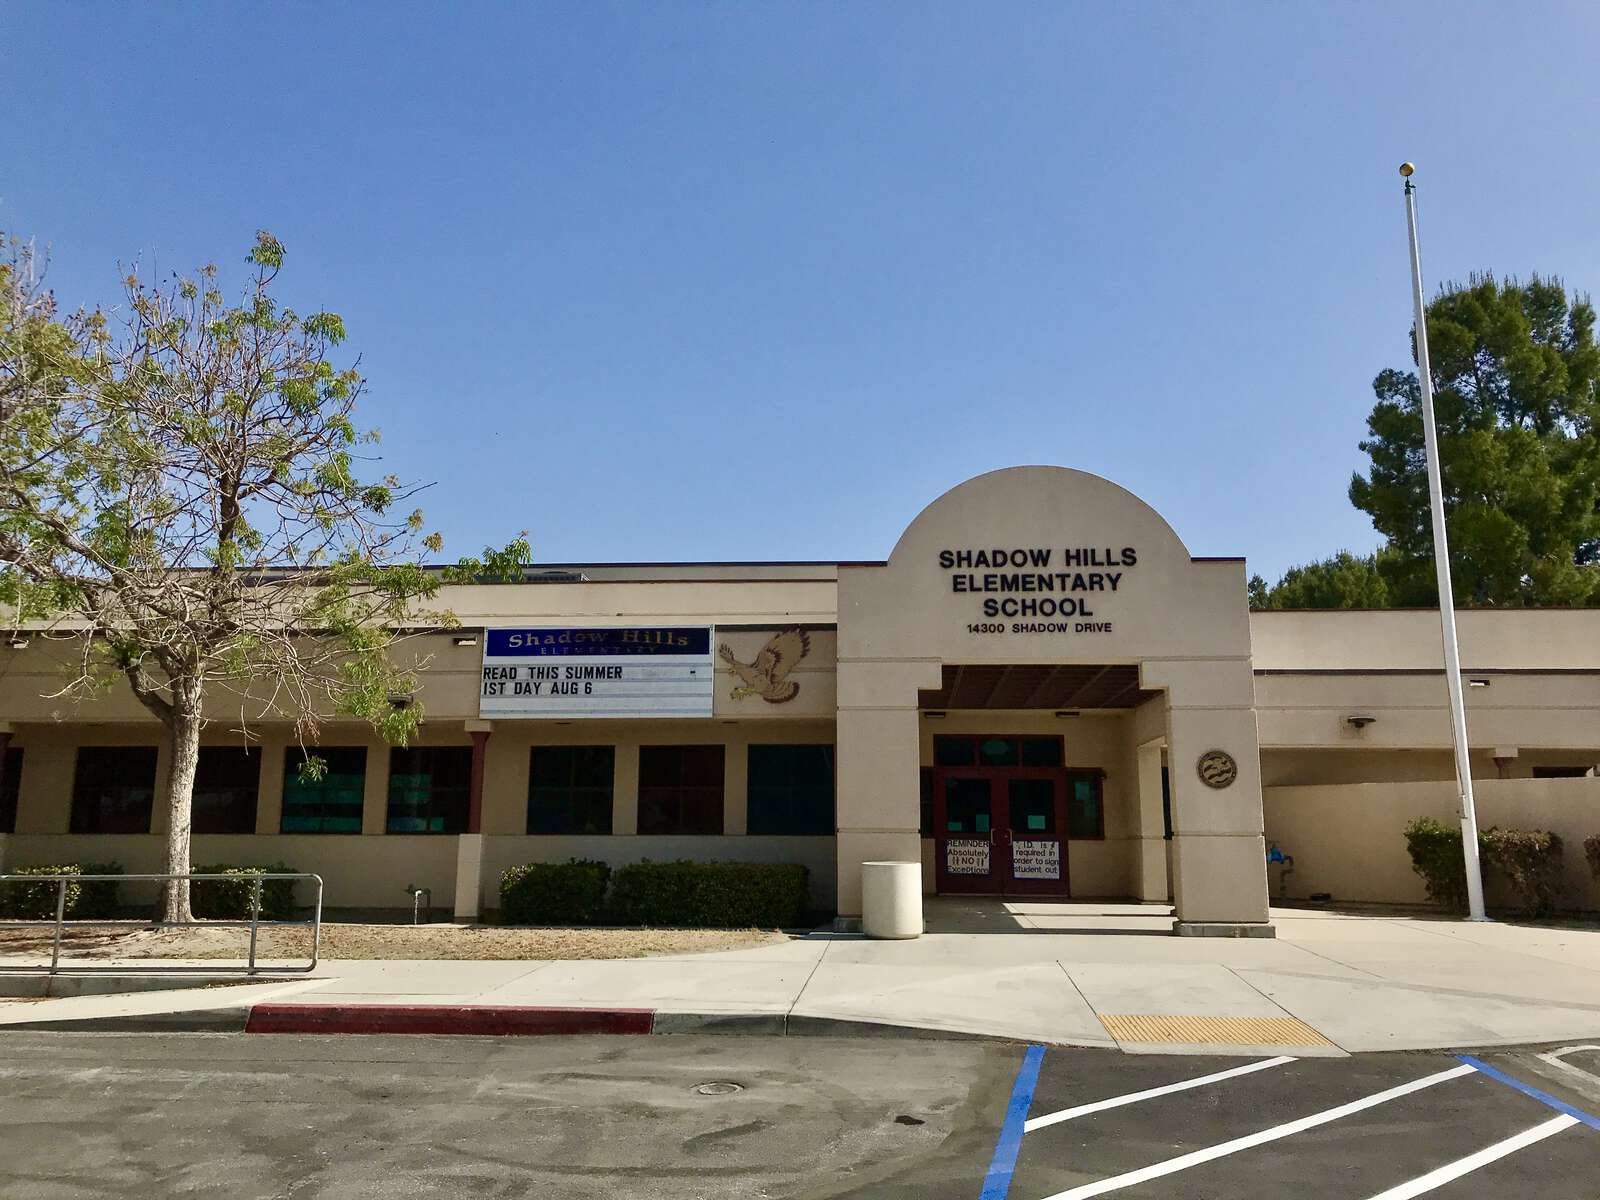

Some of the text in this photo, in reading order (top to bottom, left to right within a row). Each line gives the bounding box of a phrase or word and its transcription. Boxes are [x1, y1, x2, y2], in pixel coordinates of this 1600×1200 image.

[939, 547, 1138, 569] SHADOW HILLS
[952, 572, 1122, 592] ELEMENTARY
[983, 597, 1093, 617] SCHOOL
[967, 622, 1112, 634] 14300 SHADOW DRIVE
[508, 629, 689, 648] Shadow Hills
[483, 665, 622, 680] READ THIS SUMMER
[514, 682, 542, 695] DAY
[550, 682, 578, 695] AUG
[584, 682, 593, 695] 6
[947, 840, 989, 848] REMINDER
[948, 848, 989, 859] Absolutely
[1015, 849, 1046, 858] required
[961, 857, 975, 865] NO
[1013, 857, 1034, 865] order
[1044, 858, 1059, 867] sign
[1013, 866, 1058, 874] student out
